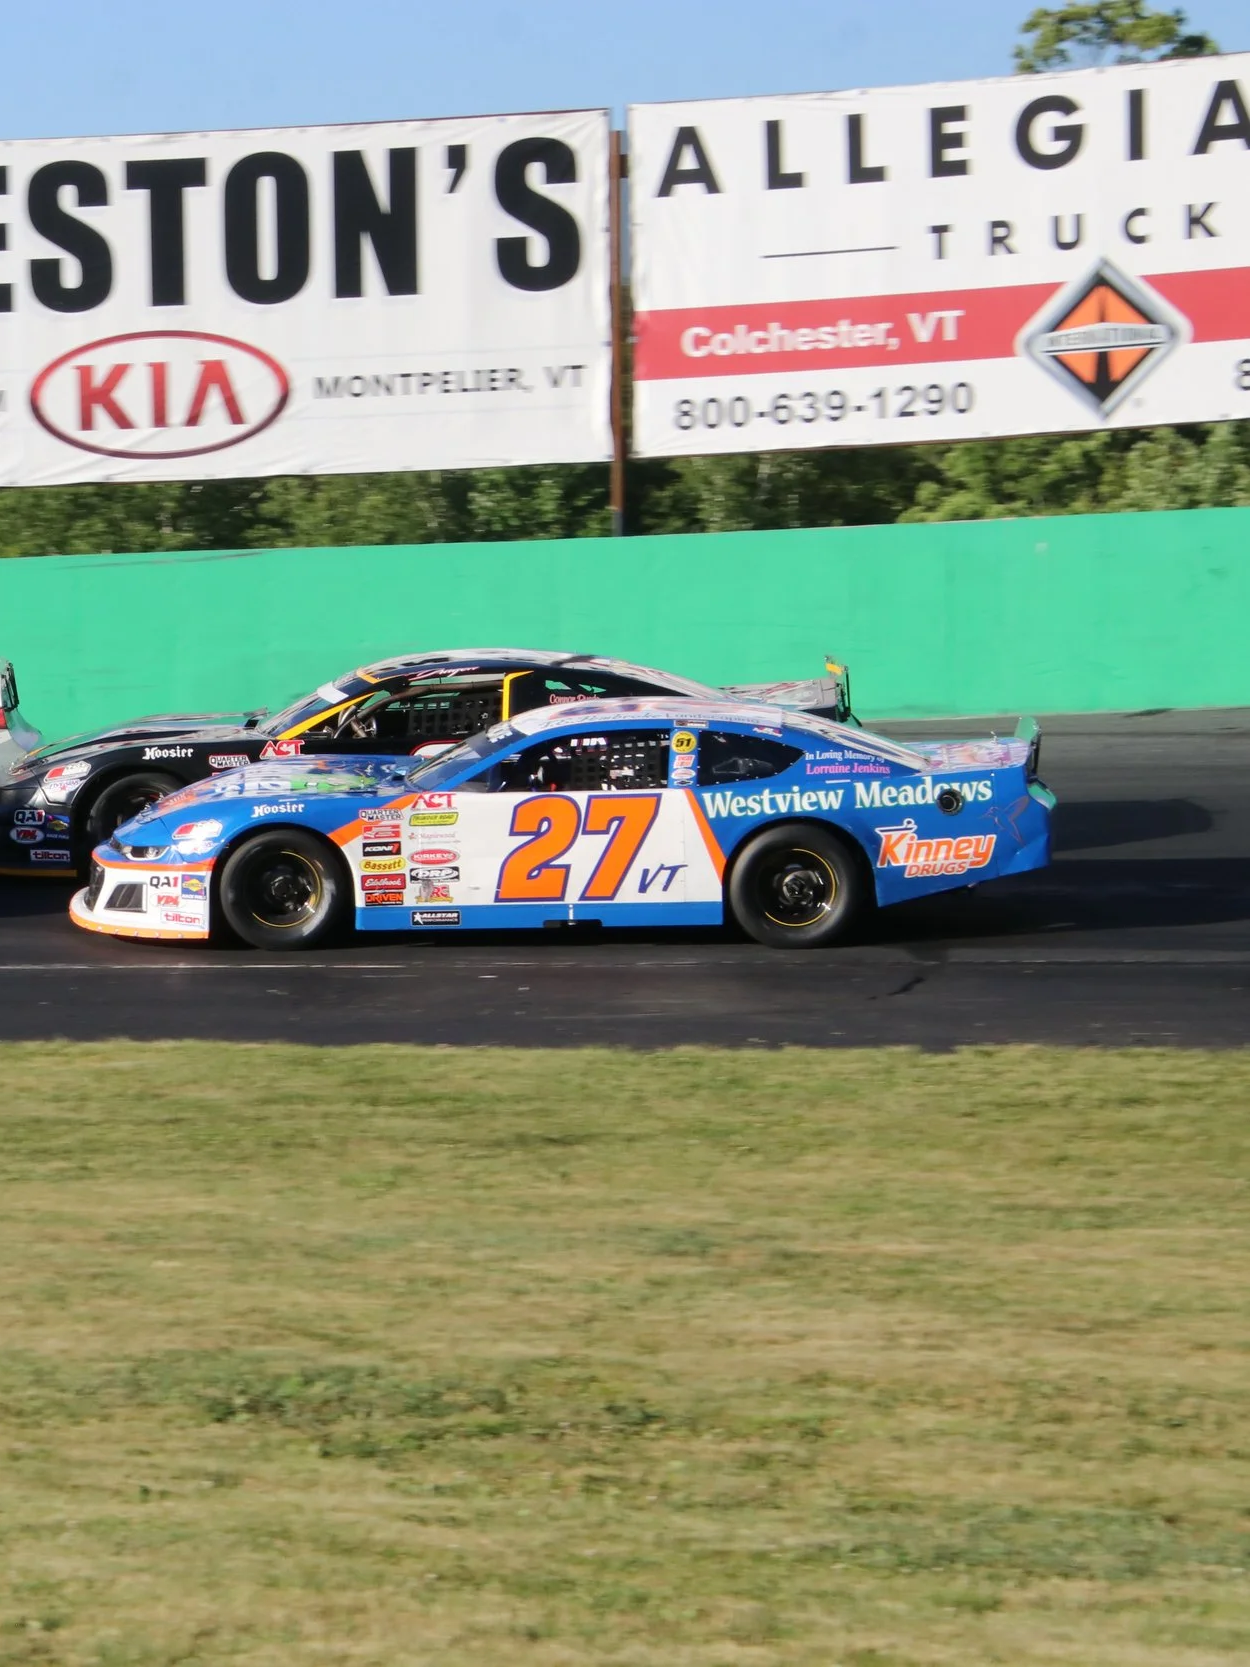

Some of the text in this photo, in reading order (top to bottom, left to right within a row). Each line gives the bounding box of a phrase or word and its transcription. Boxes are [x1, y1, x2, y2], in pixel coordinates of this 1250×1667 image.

[657, 79, 1250, 198] ALLEGIA
[928, 203, 1221, 260] TRUCK
[681, 310, 966, 358] Colchester, VT
[313, 364, 587, 400] MONTPELIER, VT
[73, 359, 245, 432] KIA
[674, 381, 975, 431] 800-639-1290
[261, 740, 304, 756] ACT
[675, 737, 692, 748] 51
[142, 746, 194, 760] Hoosier
[209, 756, 247, 765] QUARTER
[805, 751, 814, 760] In
[816, 750, 842, 761] Loving
[844, 750, 876, 763] Memory
[806, 763, 890, 775] Lorraine Jenkins
[411, 793, 457, 808] ACT
[702, 786, 845, 819] Westview
[15, 811, 44, 824] QA1
[251, 802, 305, 818] Hoosier
[360, 809, 399, 818] QUARTER
[32, 851, 69, 861] tilton
[493, 793, 689, 904] 27 VT
[877, 832, 997, 868] Kinney
[364, 860, 402, 870] Bassett
[905, 861, 968, 877] DRUGS
[150, 875, 179, 889] QA1
[366, 894, 403, 903] DRIVEN
[164, 913, 201, 923] tilton
